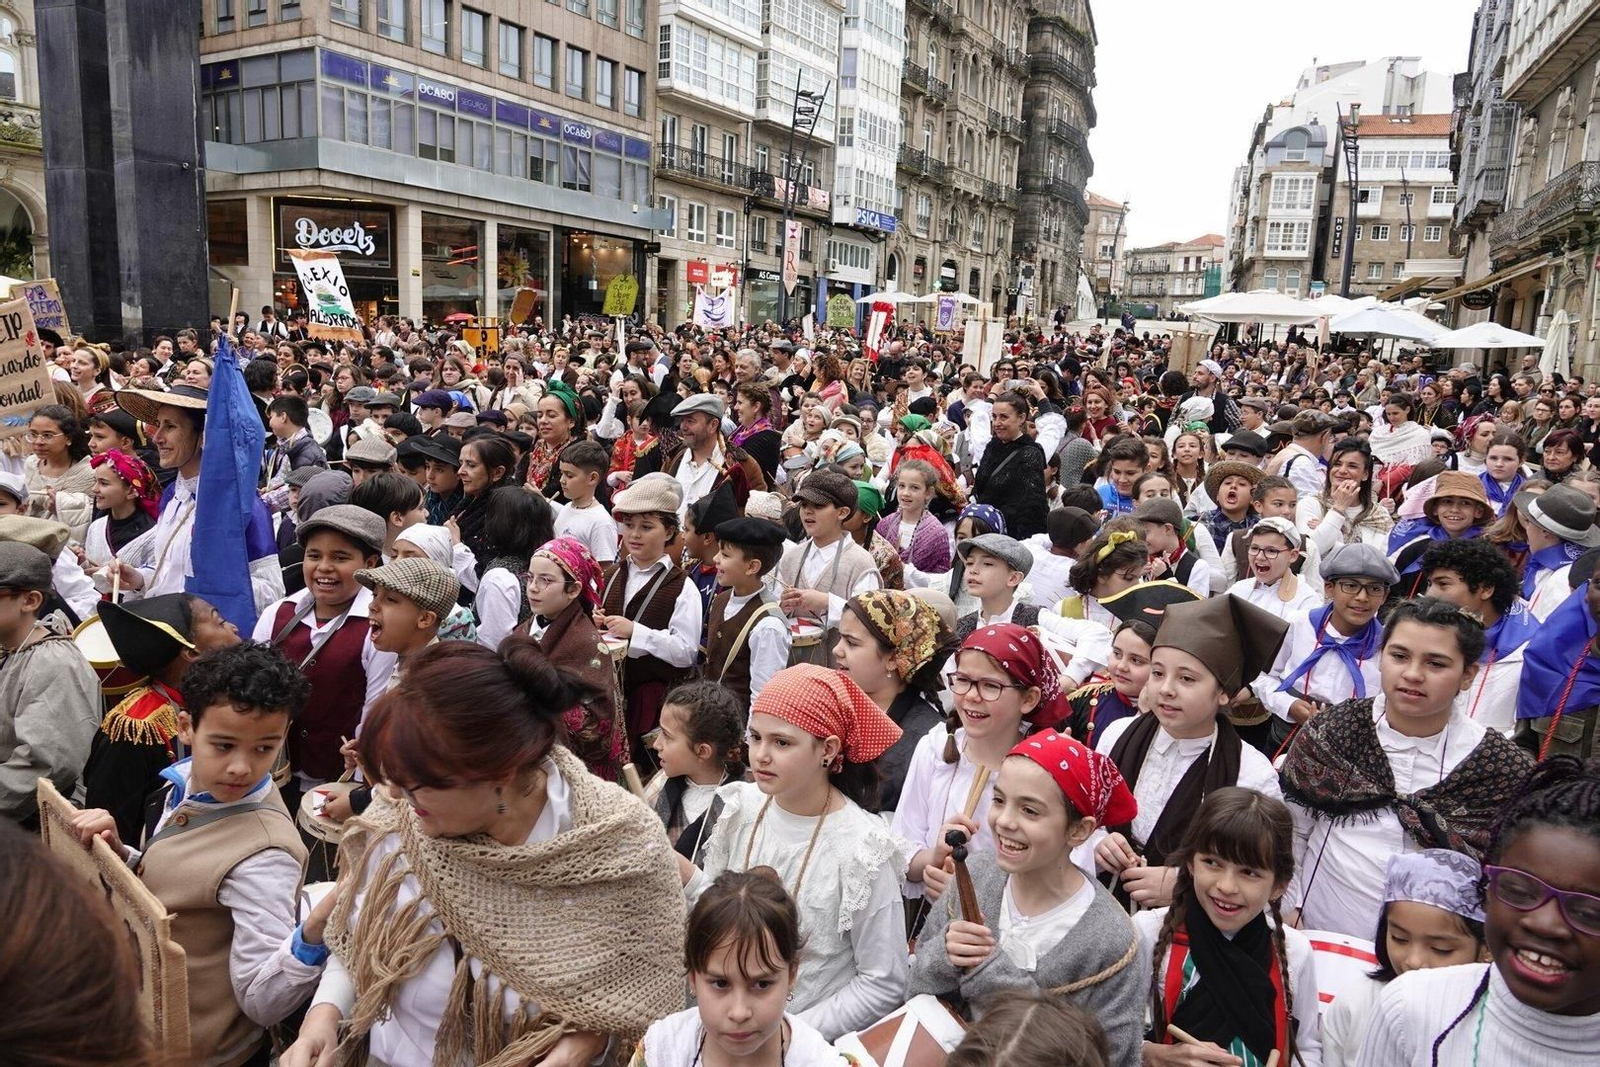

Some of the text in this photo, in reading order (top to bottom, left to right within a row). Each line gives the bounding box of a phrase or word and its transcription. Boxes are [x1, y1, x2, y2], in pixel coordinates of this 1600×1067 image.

[418, 82, 488, 112] OCASO SEGUROS
[564, 124, 591, 139] OCASO
[856, 208, 880, 228] PSICA
[295, 217, 375, 256] Dooers
[1334, 217, 1343, 252] HOTEL
[759, 271, 766, 279] AS
